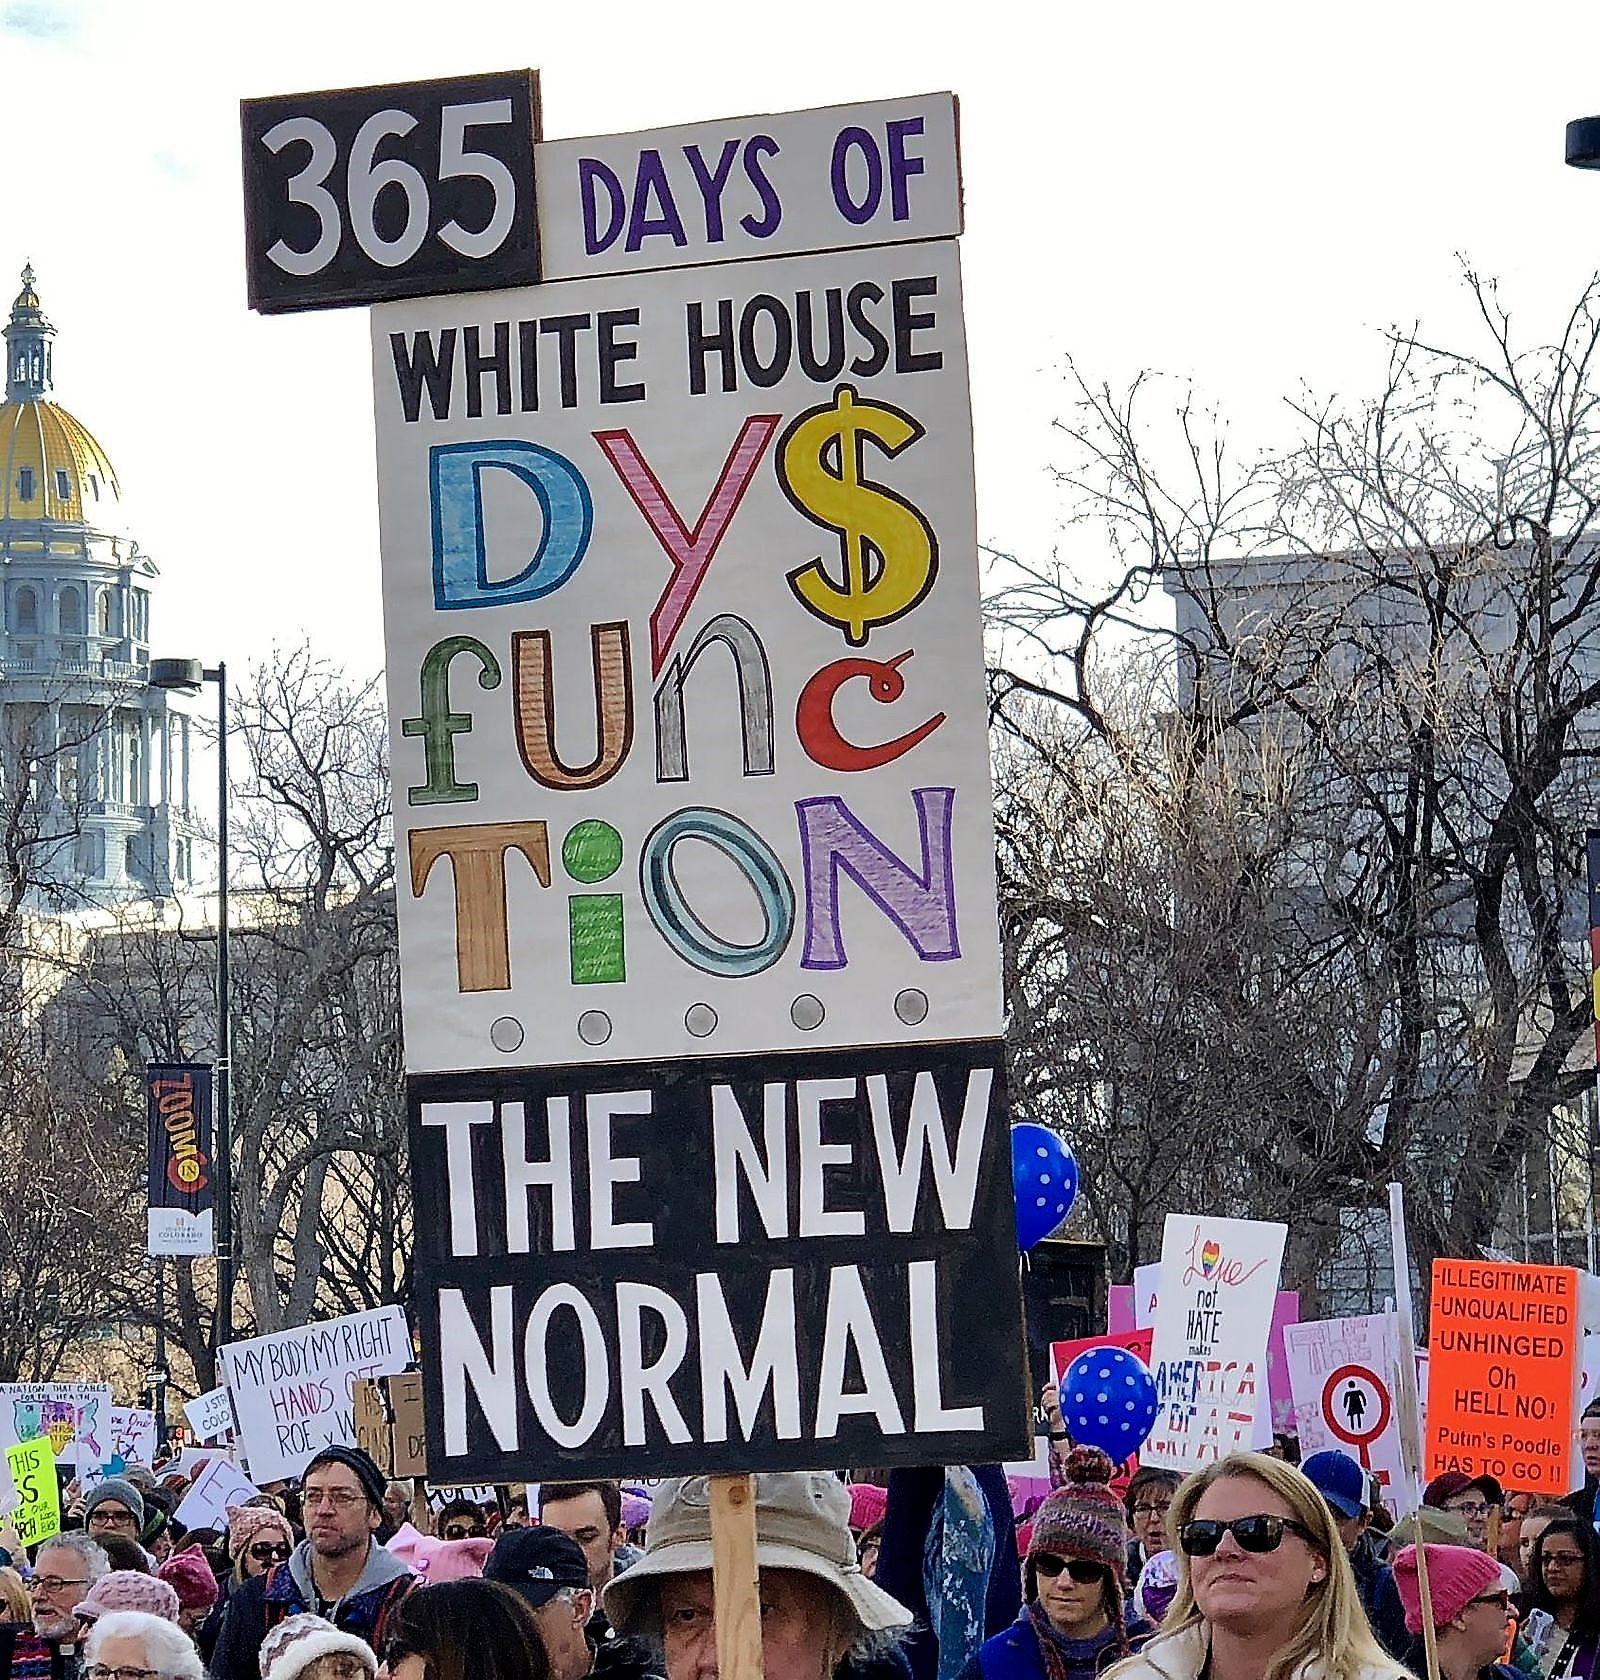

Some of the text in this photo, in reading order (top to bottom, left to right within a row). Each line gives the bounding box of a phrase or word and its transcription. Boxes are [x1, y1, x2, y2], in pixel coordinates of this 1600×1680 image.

[260, 98, 925, 276] 365 DAYS OF
[390, 275, 943, 424] WHITE HOUSE
[421, 1067, 995, 1260] THE NEW
[1197, 1285, 1219, 1308] not
[1186, 1311, 1222, 1343] HATE
[233, 1346, 265, 1390] MY
[311, 1327, 340, 1371] MY
[342, 1317, 392, 1363] RIGHT
[437, 1258, 985, 1460] NORMAL
[0, 1386, 6, 1394] A
[9, 1385, 45, 1393] NATION
[1488, 1366, 1516, 1390] Oh
[270, 1377, 334, 1422] HANDS
[1455, 1389, 1556, 1420] HELL NO!
[276, 1420, 316, 1458] ROE
[1438, 1427, 1561, 1456] Putin's Poodle
[1434, 1455, 1473, 1474] HAS
[1480, 1459, 1505, 1477] TO
[1512, 1462, 1541, 1480] GO
